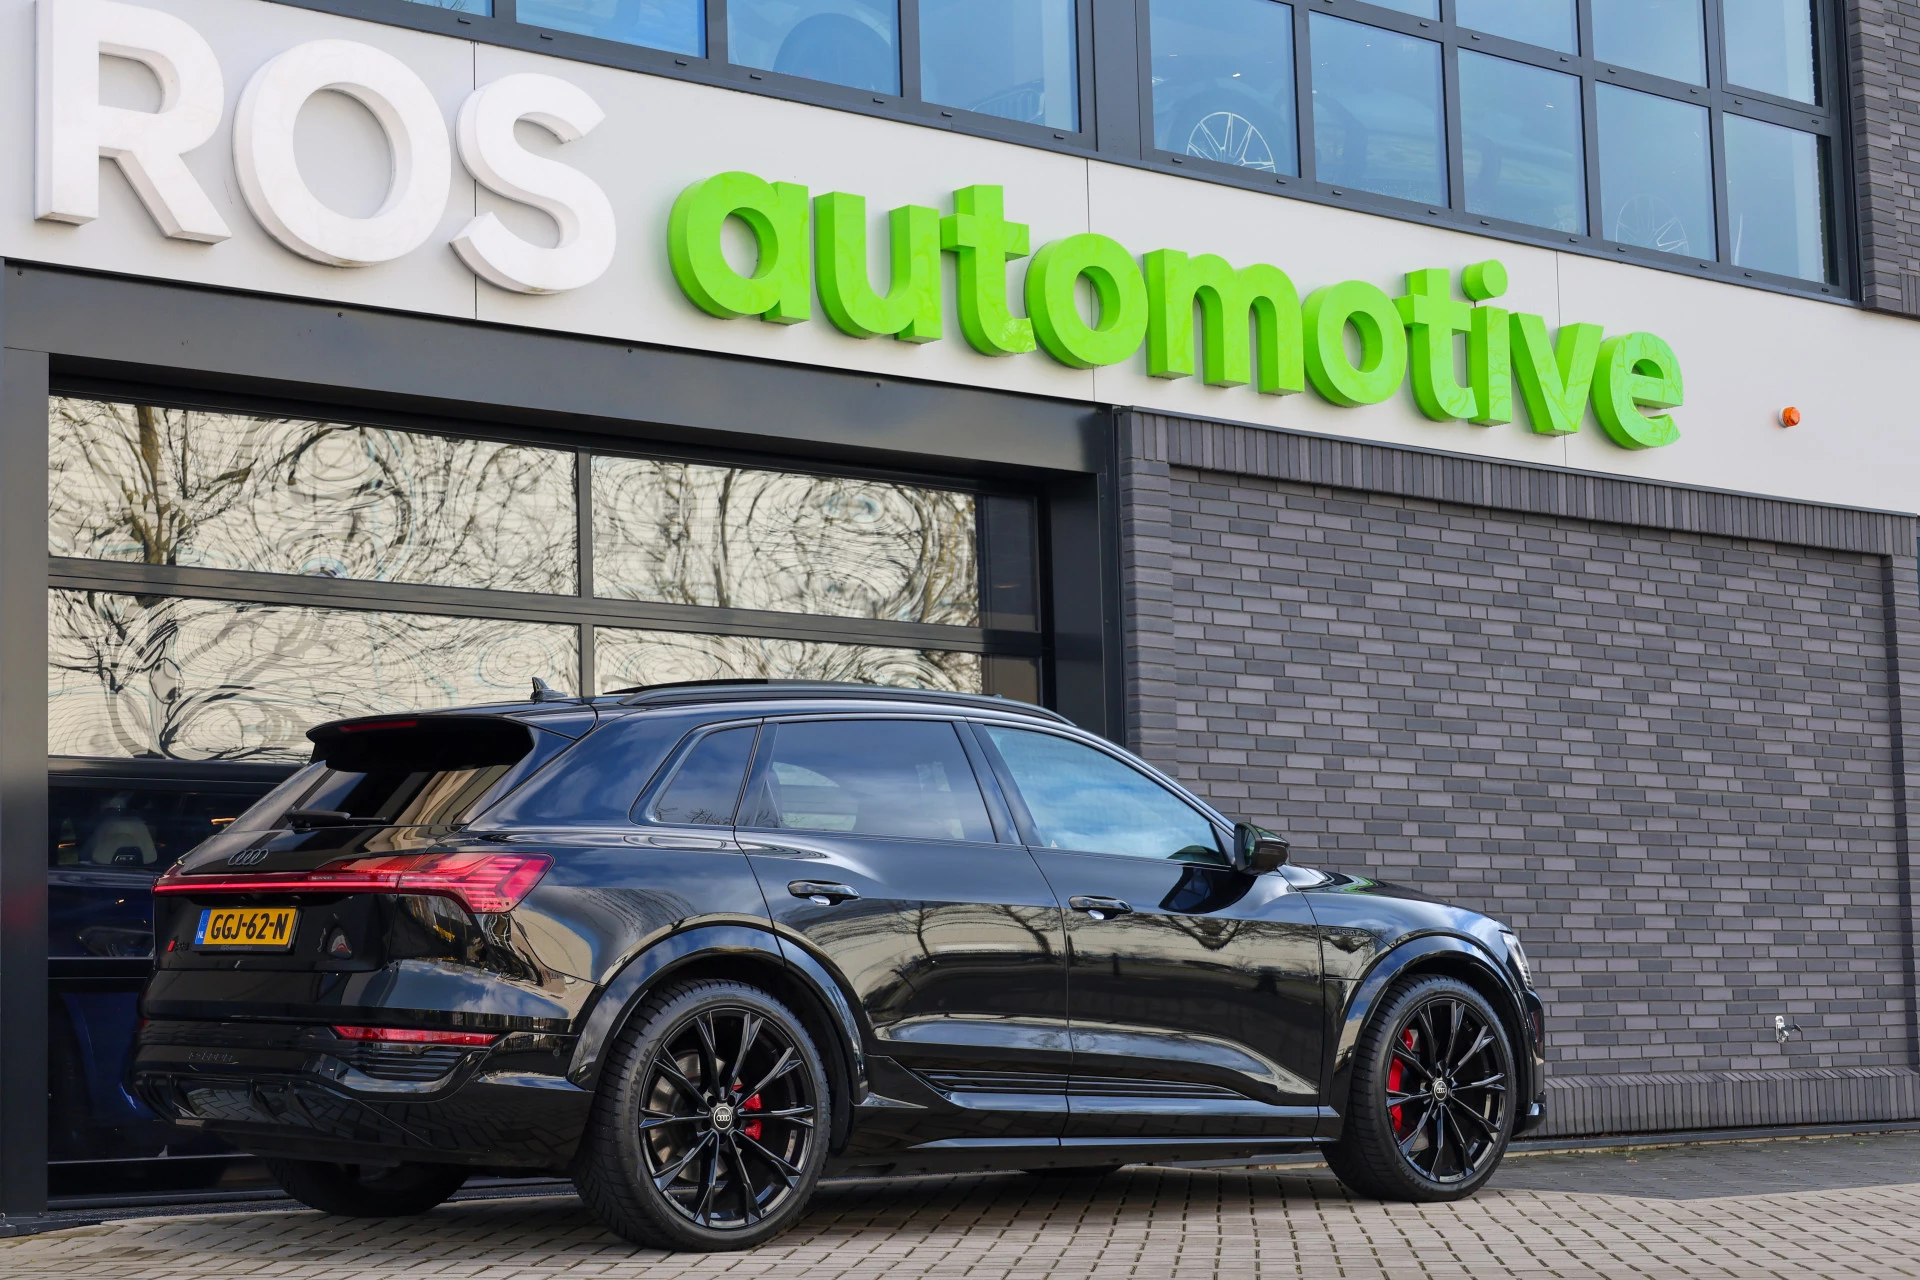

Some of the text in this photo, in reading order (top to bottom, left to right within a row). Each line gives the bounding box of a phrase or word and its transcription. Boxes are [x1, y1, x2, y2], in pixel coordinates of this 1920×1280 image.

[35, 0, 1684, 450] ROS automotive
[211, 913, 289, 939] GGJ-62-N
